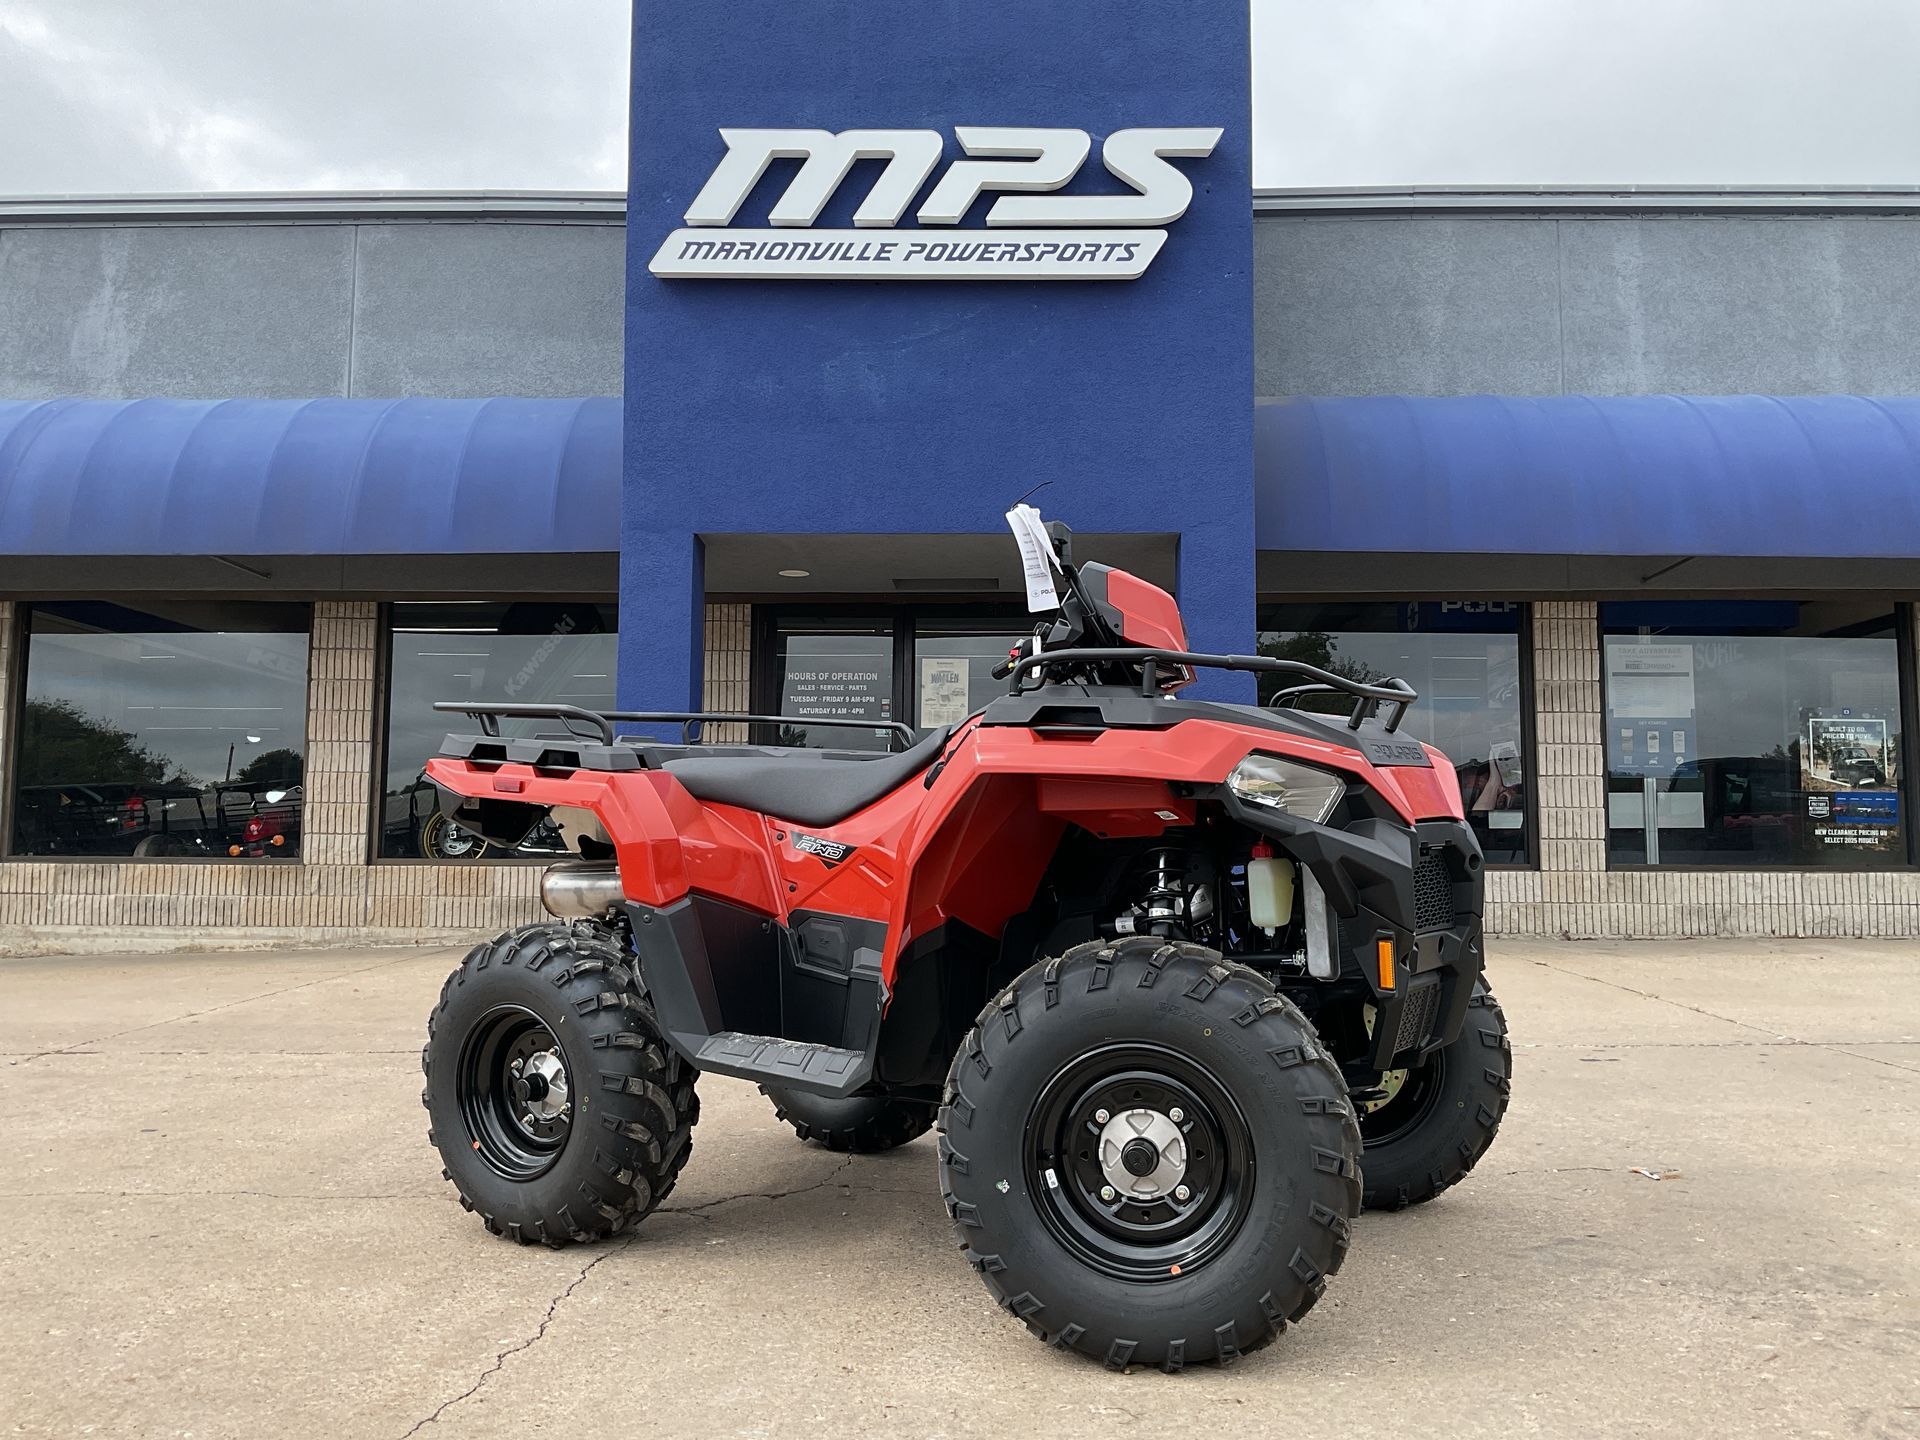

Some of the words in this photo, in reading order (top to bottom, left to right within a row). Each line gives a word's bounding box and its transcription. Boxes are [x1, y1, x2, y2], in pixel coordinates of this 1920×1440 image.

[682, 126, 1224, 228] MPS
[677, 241, 899, 262] MARIONVILLE
[902, 241, 1142, 263] POWERSPORTS
[504, 614, 576, 697] Kawasaki
[788, 672, 816, 681] HOURS
[818, 672, 829, 681] OF
[831, 672, 878, 681] OPERATION
[796, 840, 843, 859] AWD
